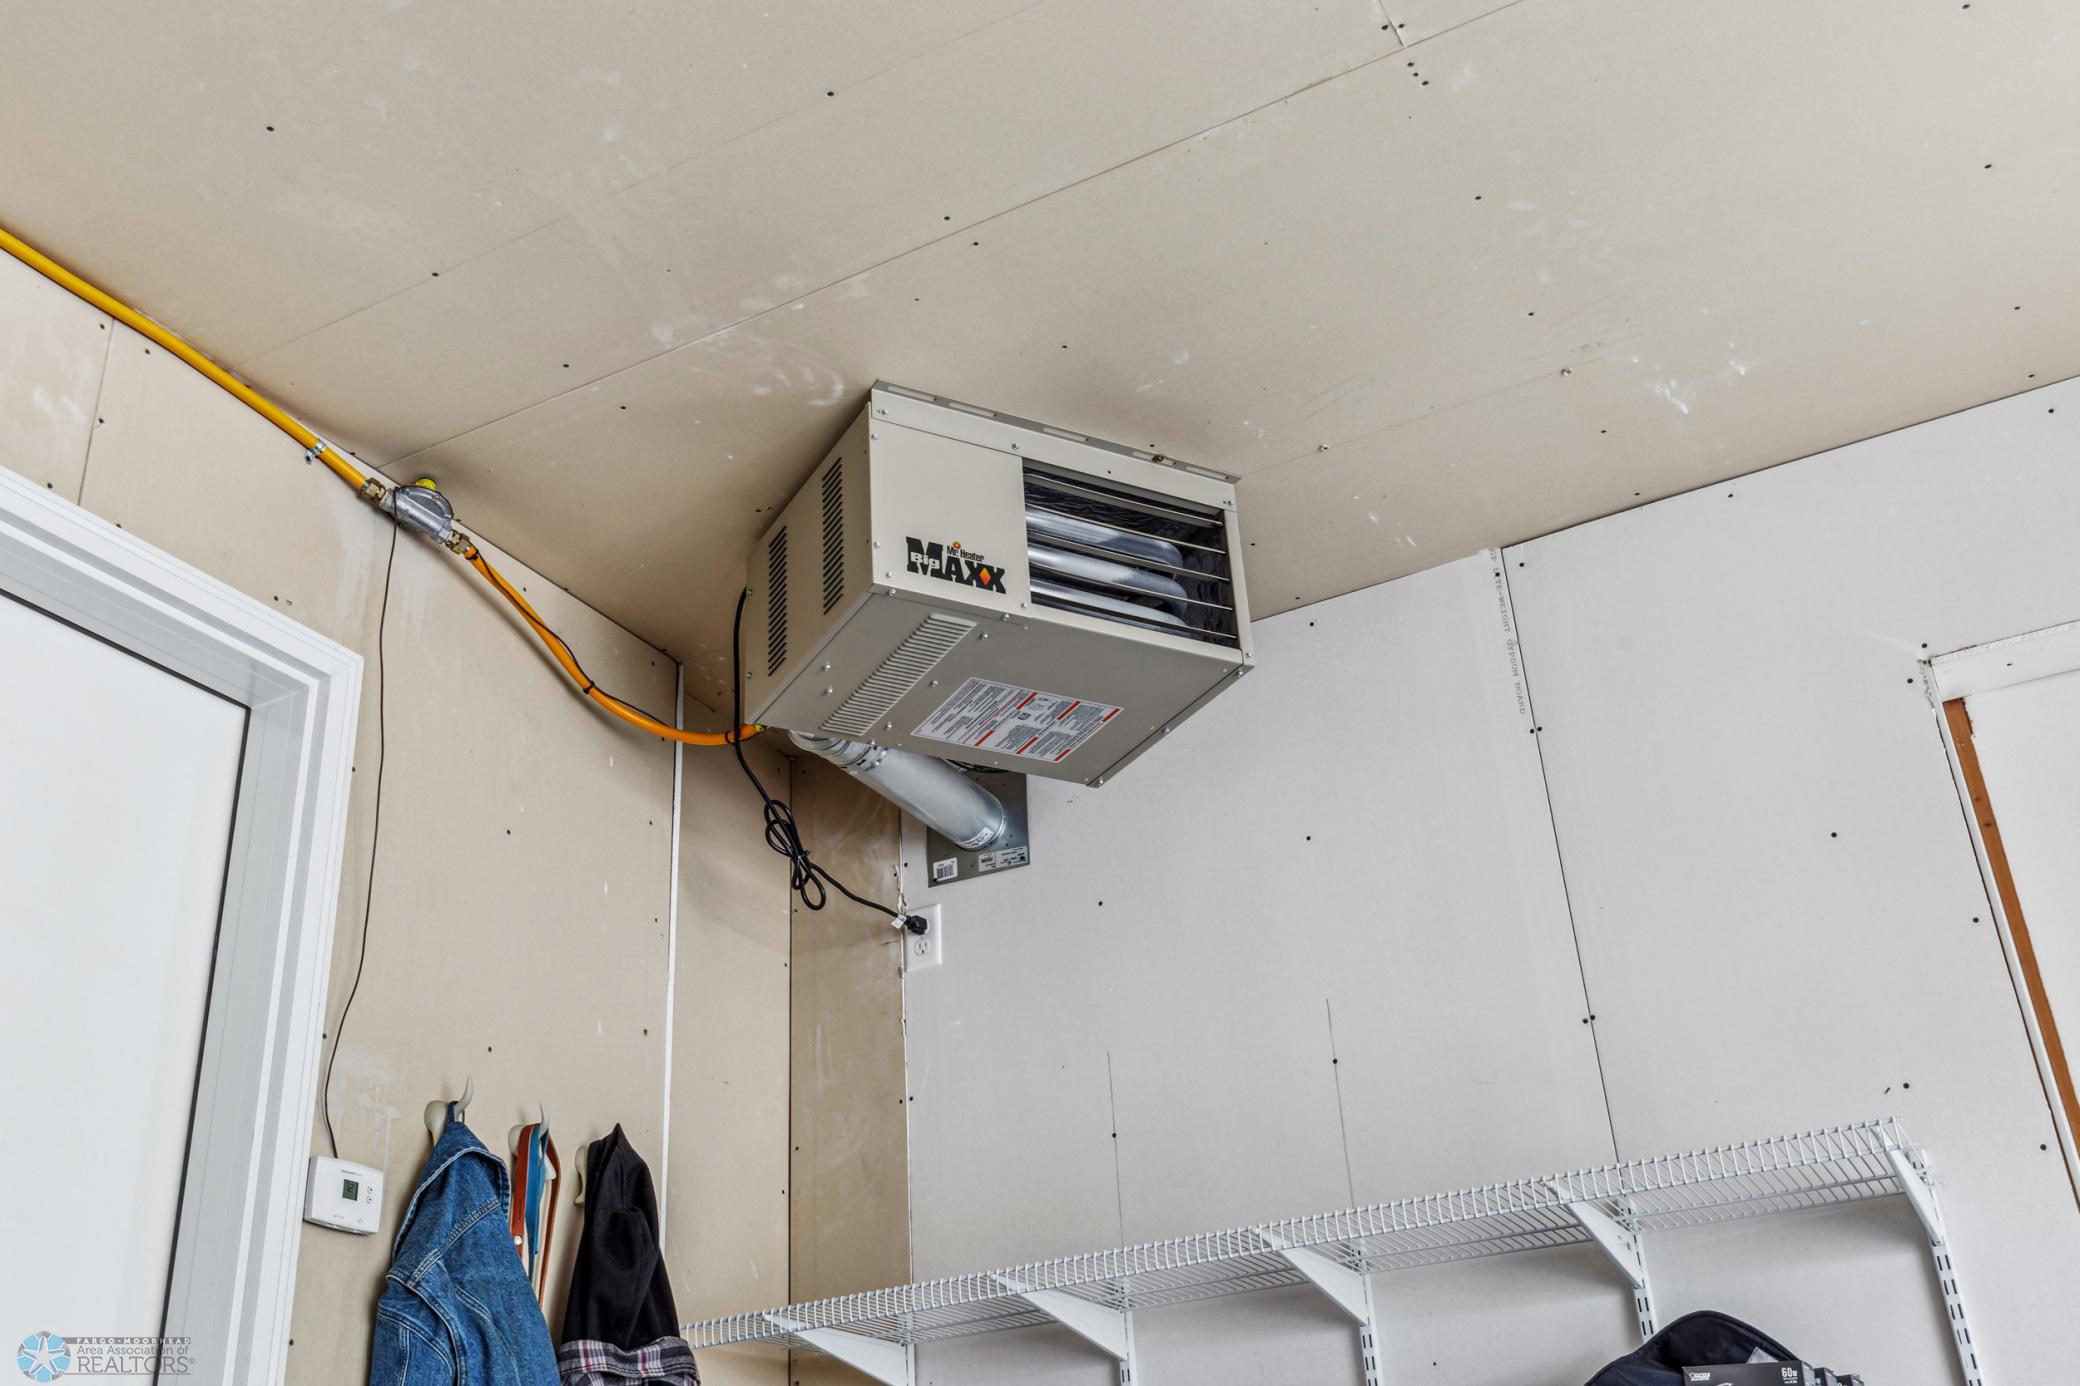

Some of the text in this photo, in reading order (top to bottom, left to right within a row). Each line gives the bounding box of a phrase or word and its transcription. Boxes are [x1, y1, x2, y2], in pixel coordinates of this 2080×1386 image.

[906, 536, 1006, 594] Big MAXX
[960, 548, 985, 562] Heater
[1493, 567, 1511, 632] LTE-WEIGHT
[1506, 638, 1519, 677] GYPSUM
[1514, 682, 1526, 714] BOARD
